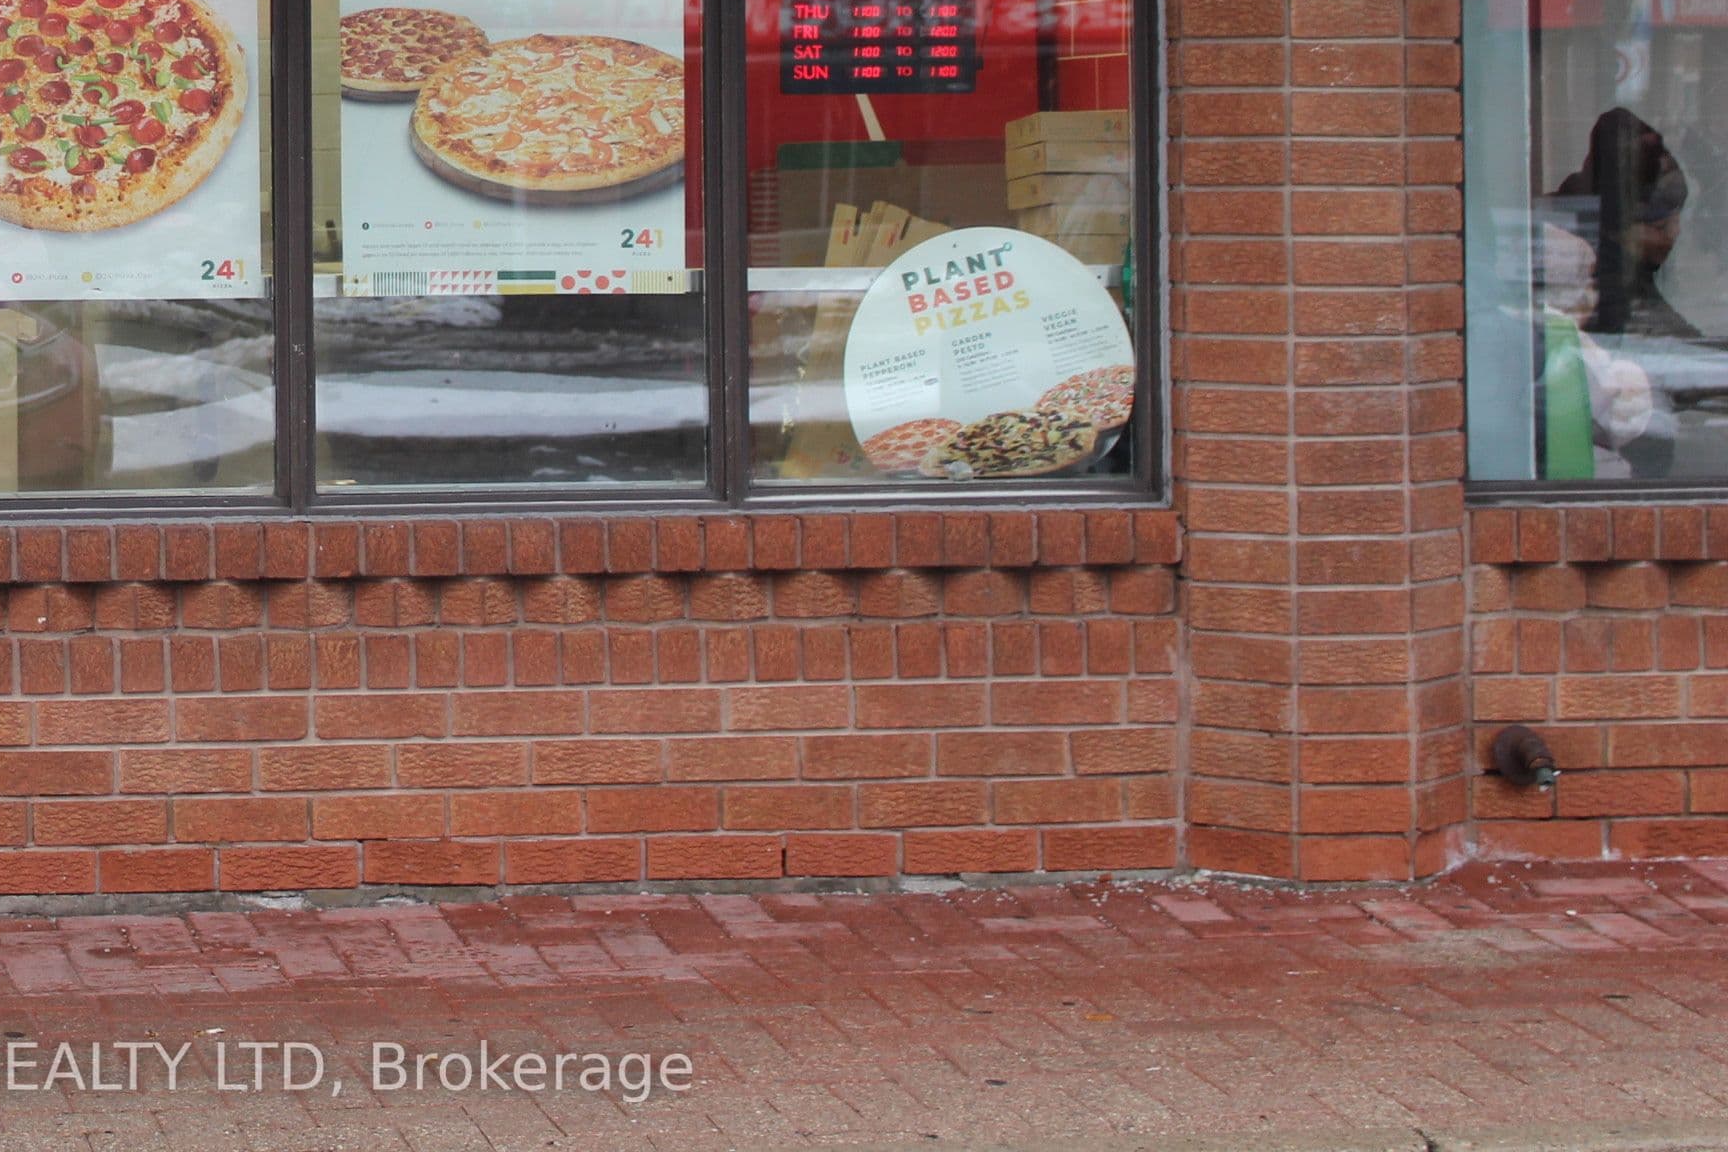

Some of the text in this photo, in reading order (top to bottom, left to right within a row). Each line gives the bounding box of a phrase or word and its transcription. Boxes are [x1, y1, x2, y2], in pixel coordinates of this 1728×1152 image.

[794, 5, 829, 19] THU
[794, 25, 819, 39] FRI
[794, 45, 823, 59] SAT
[793, 65, 829, 79] SUN
[621, 228, 663, 249] 241
[201, 259, 245, 280] 241
[901, 245, 1008, 291] PLANT
[908, 271, 1014, 313] BASED
[914, 290, 1030, 336] PIZZAS
